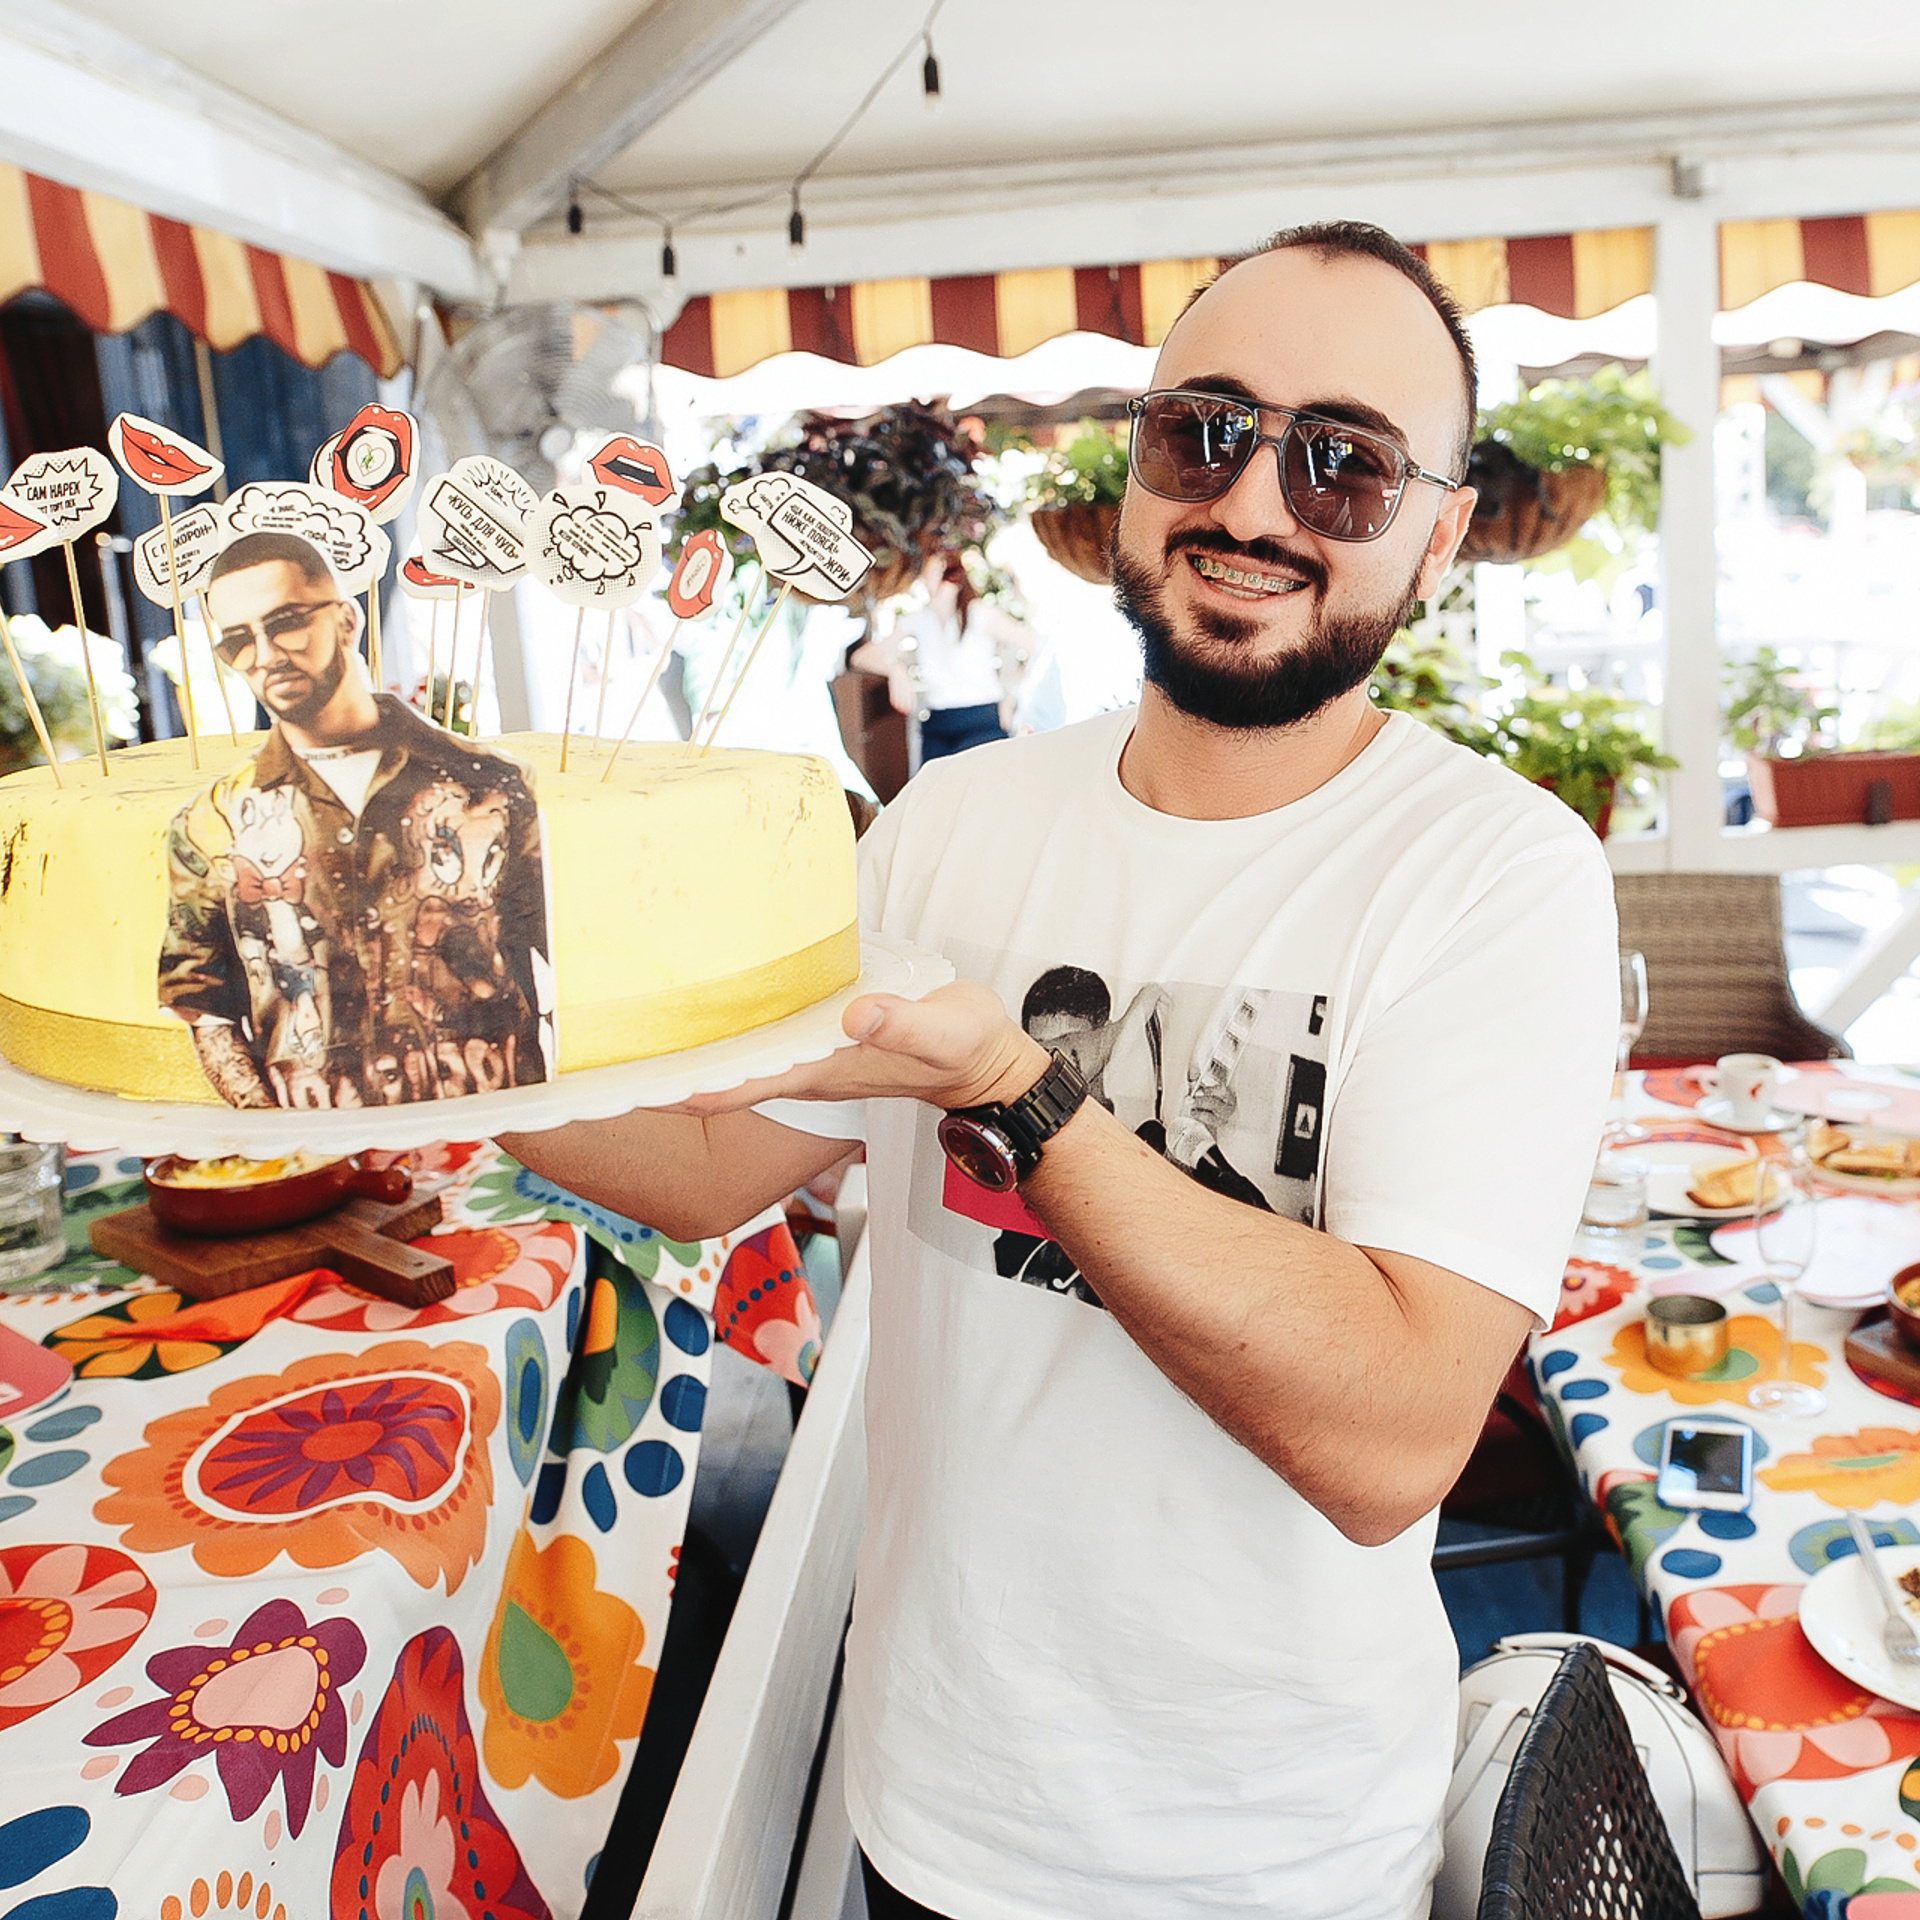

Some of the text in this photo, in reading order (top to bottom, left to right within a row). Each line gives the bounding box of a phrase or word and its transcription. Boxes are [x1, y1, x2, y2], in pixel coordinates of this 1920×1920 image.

[27, 480, 81, 501] САМ НАРЕК
[470, 517, 496, 538] ДЛЯ
[781, 511, 810, 535] НИЖЕ
